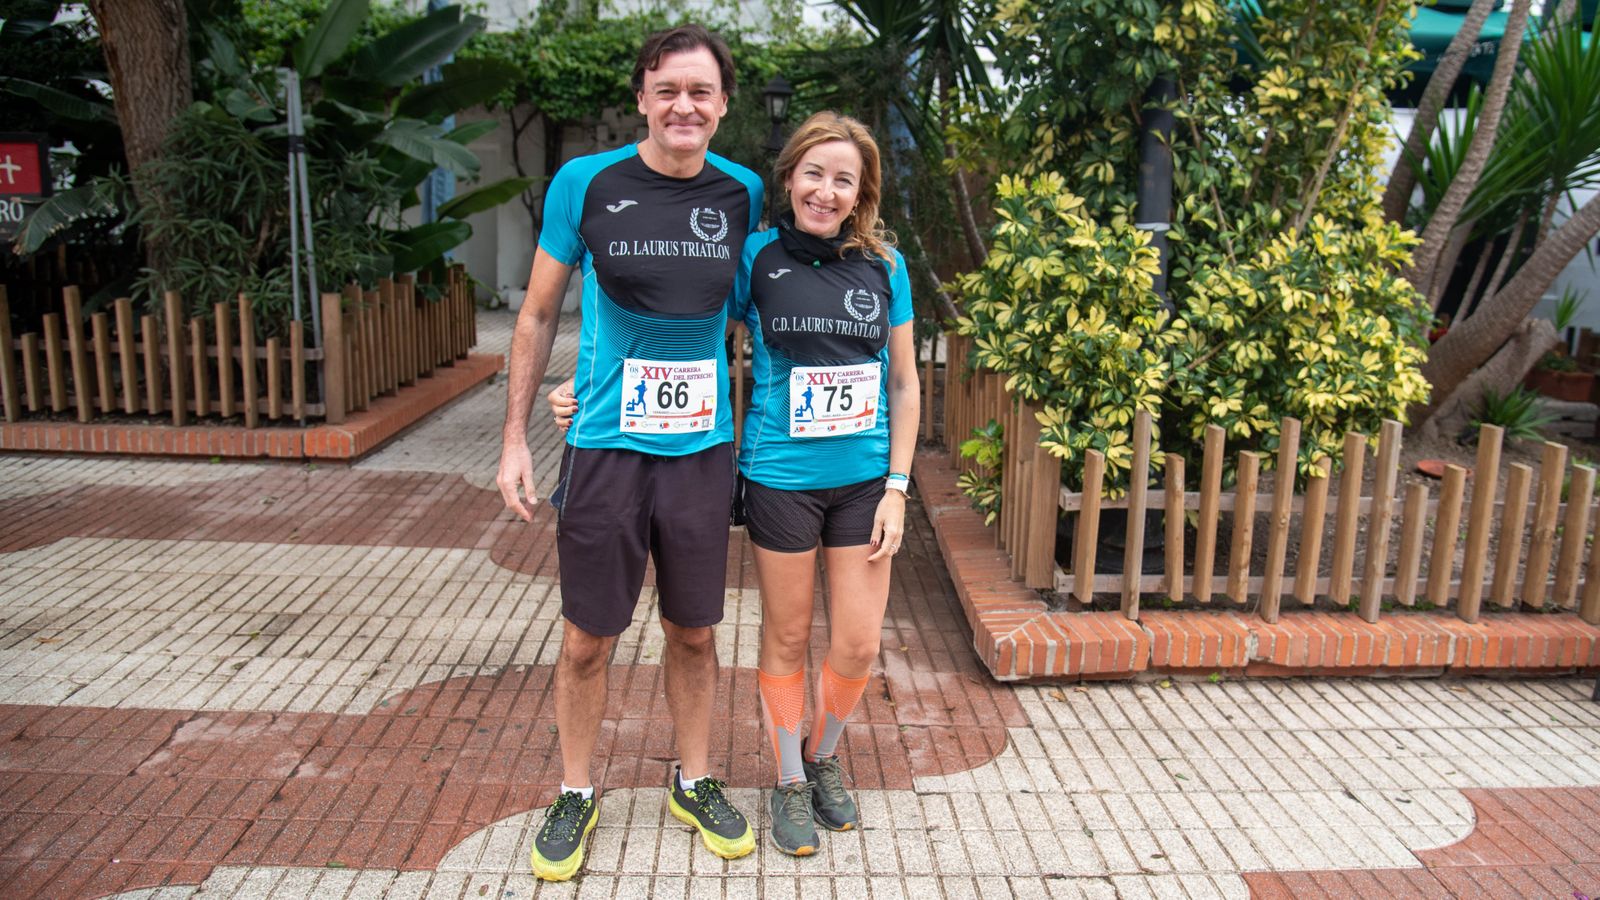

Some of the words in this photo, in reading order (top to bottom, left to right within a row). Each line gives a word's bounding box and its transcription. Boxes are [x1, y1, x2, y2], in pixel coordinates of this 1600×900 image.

[609, 241, 631, 256] C.D.
[633, 240, 679, 256] LAURUS
[681, 241, 730, 260] TRIATLON
[772, 317, 790, 332] C.D.
[792, 317, 834, 333] LAURUS
[835, 319, 881, 340] TRIATLON
[641, 366, 673, 380] XIV
[806, 371, 837, 385] XIV
[850, 375, 877, 383] ESTRECHO
[657, 381, 689, 409] 66
[823, 384, 853, 412] 75
